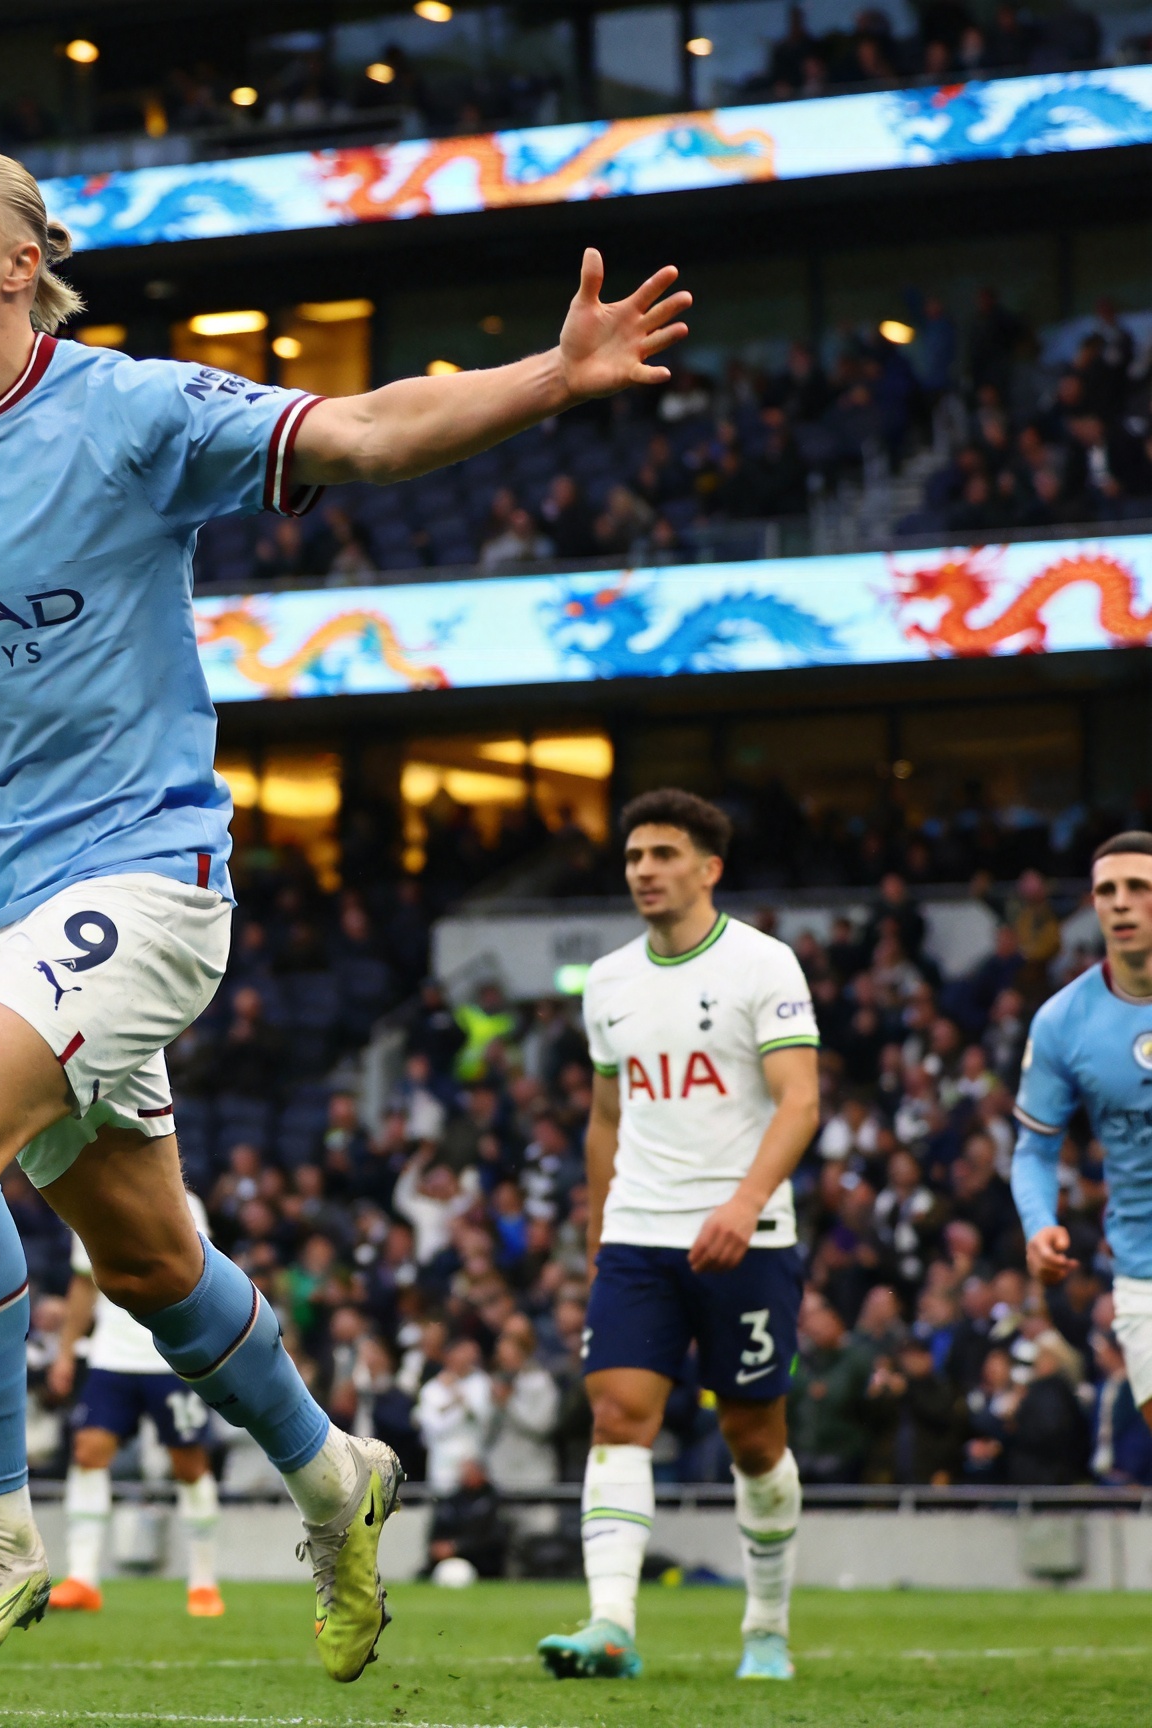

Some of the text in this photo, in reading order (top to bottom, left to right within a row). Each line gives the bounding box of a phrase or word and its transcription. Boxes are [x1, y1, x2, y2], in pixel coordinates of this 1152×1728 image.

[53, 910, 119, 973] 9
[626, 1051, 727, 1101] AIA
[740, 1308, 775, 1366] 3
